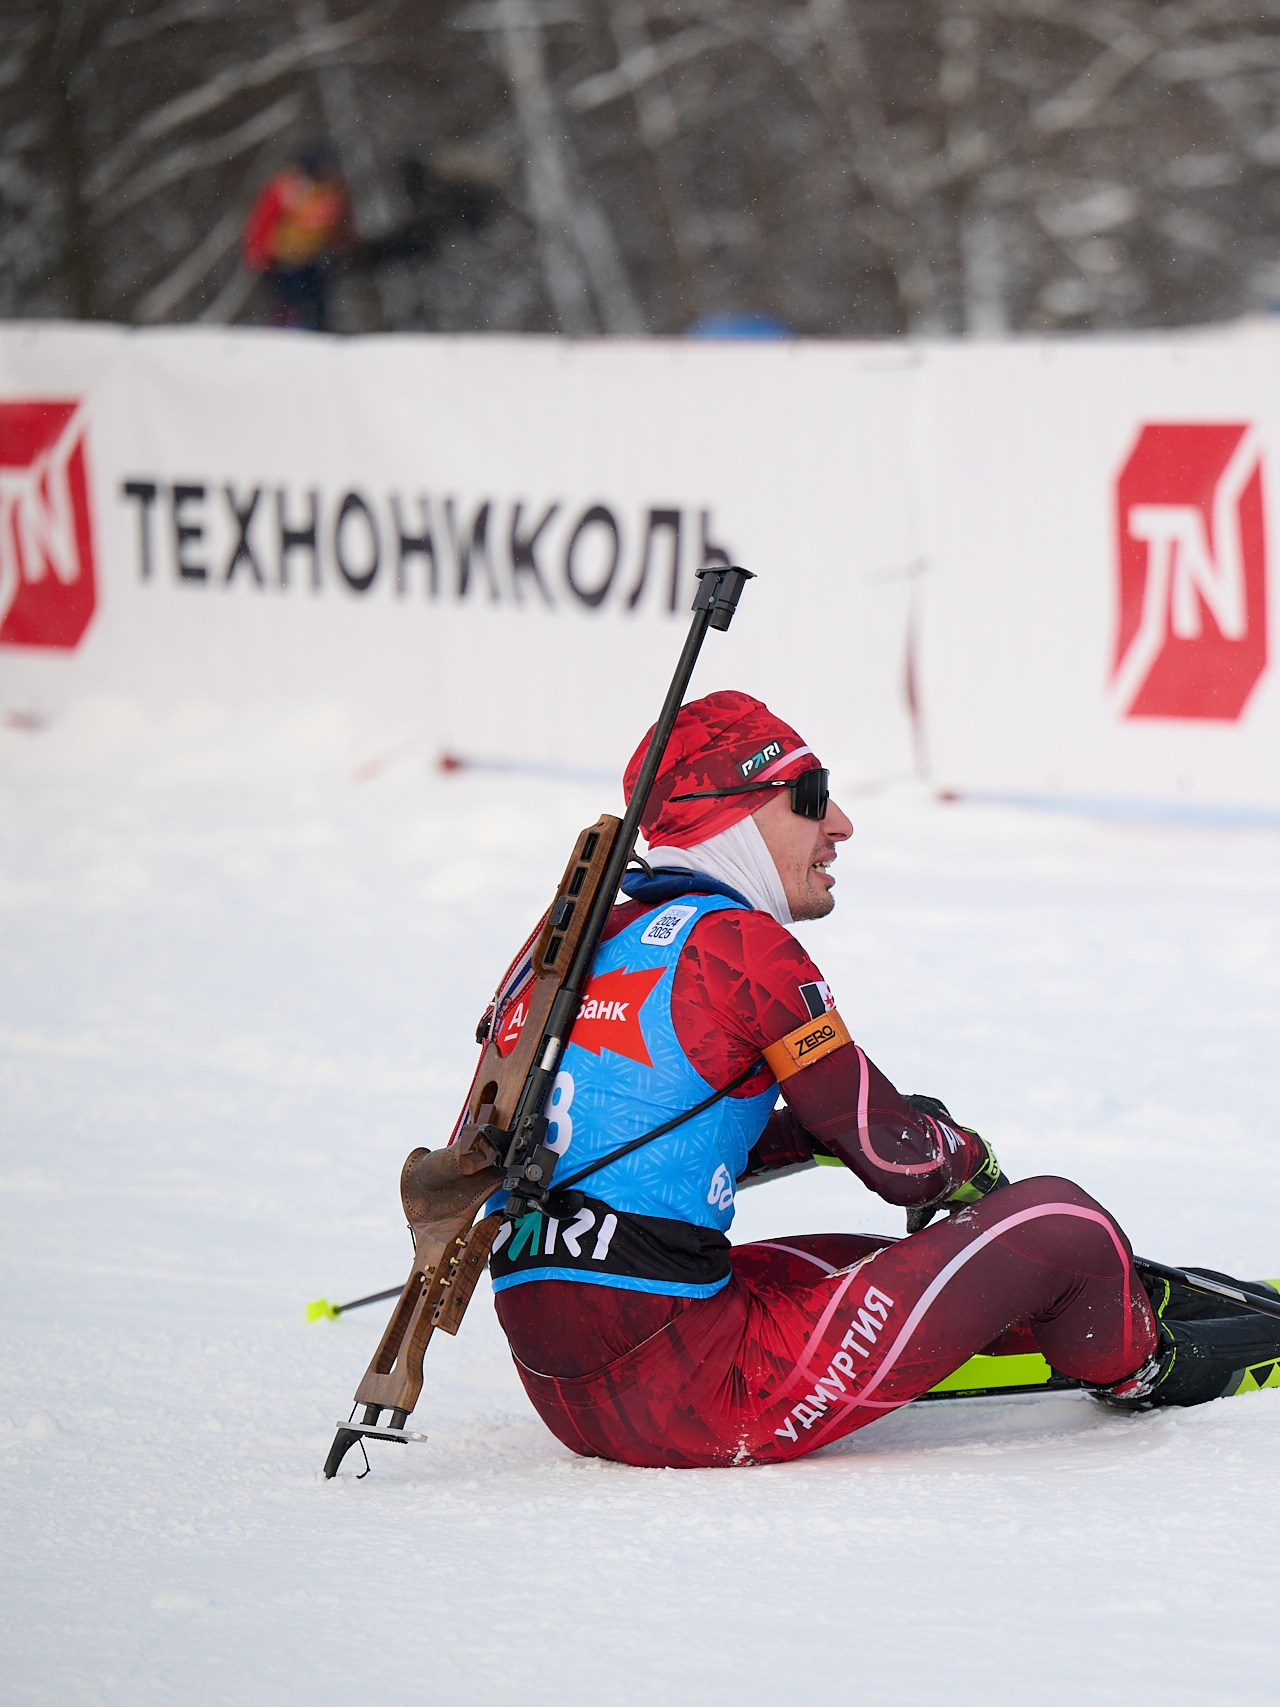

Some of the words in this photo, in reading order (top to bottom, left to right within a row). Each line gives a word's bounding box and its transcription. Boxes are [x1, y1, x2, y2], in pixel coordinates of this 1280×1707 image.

[741, 741, 781, 777] PARI
[647, 926, 673, 939] 2025
[655, 916, 682, 928] 2024
[794, 1025, 836, 1057] ZERO
[774, 1285, 894, 1442] УДМУРТИЯ
